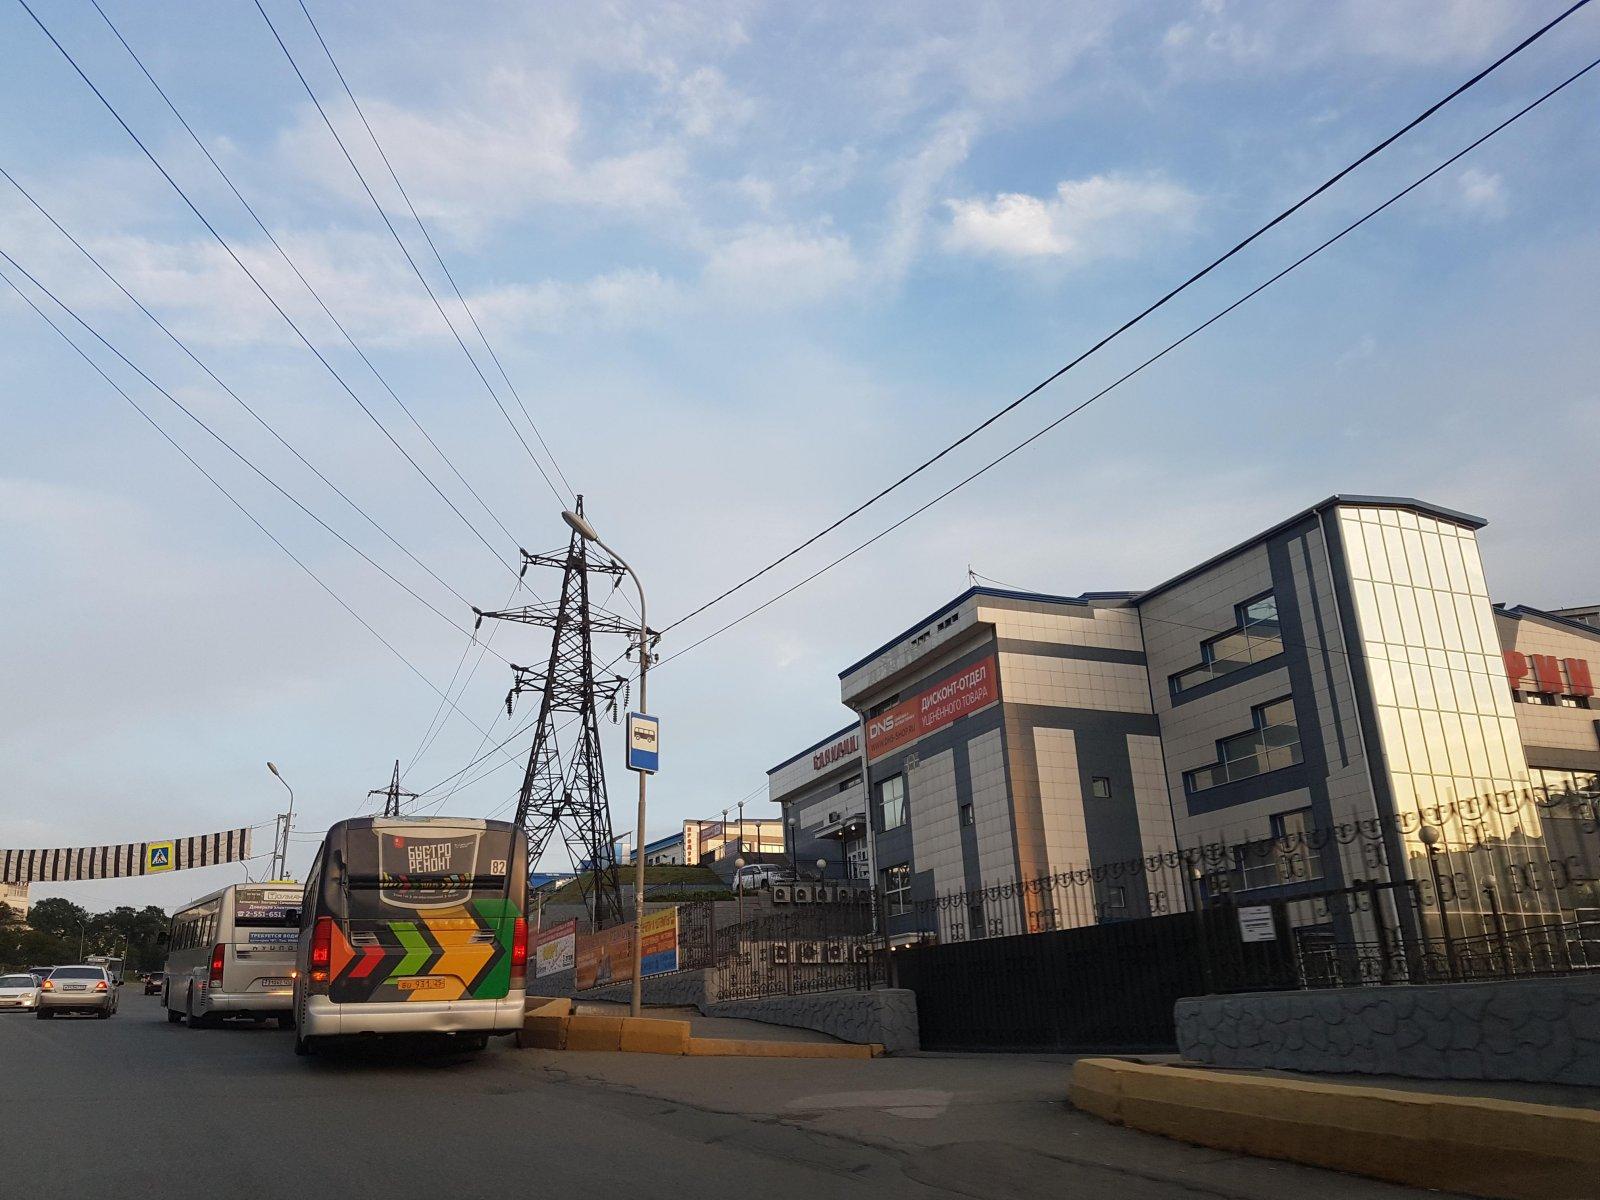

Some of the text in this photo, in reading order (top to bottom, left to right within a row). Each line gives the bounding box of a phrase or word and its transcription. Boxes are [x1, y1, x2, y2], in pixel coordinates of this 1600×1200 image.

[921, 666, 986, 713] ДИСКОНТ-ОТДЕЛ
[921, 699, 962, 728] УЦЕНЁННОГО
[962, 686, 988, 709] ТОВАРА
[870, 715, 894, 739] DNS
[407, 842, 452, 860] БЫСТРО
[409, 855, 452, 874] РЕМОНТ
[492, 861, 505, 874] 82
